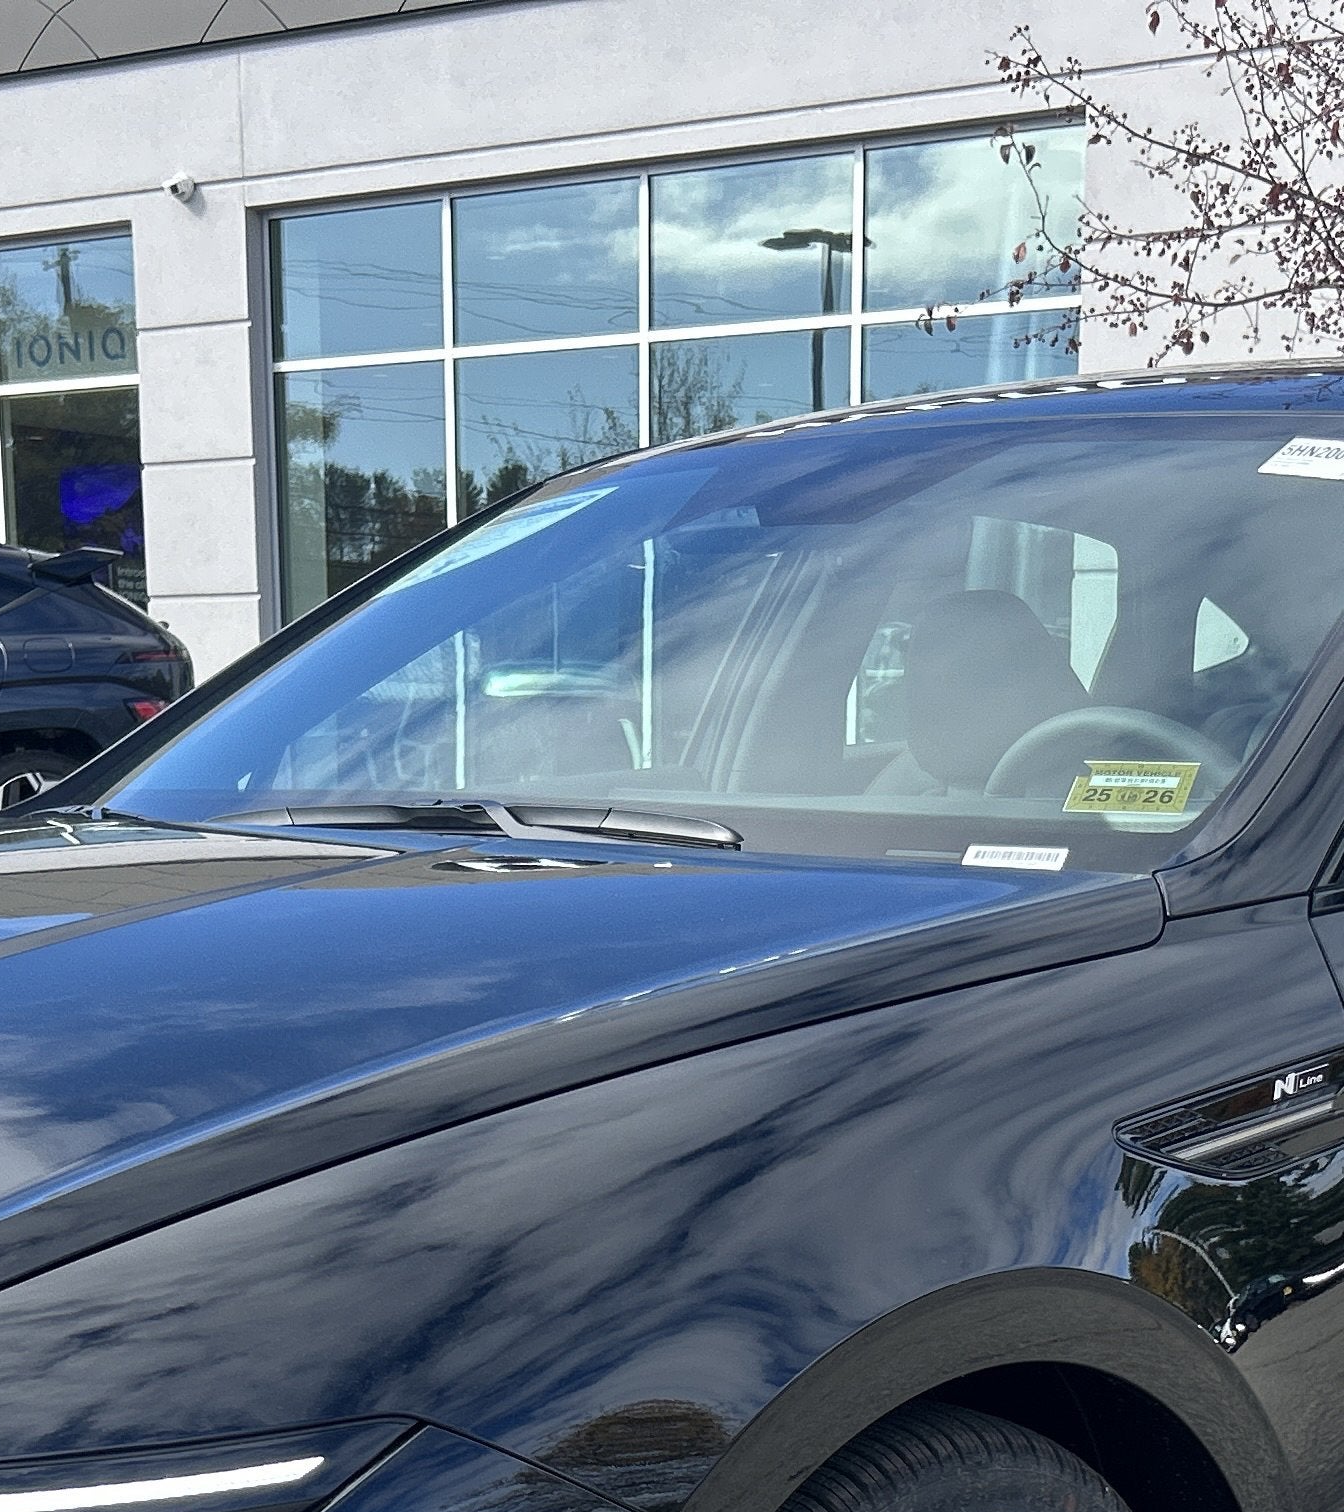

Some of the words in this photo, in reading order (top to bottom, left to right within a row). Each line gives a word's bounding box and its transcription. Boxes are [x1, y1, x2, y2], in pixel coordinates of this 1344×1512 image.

[16, 326, 127, 369] IONIQ
[1081, 788, 1113, 802] 25
[1142, 789, 1175, 804] 26
[1273, 1072, 1299, 1101] N
